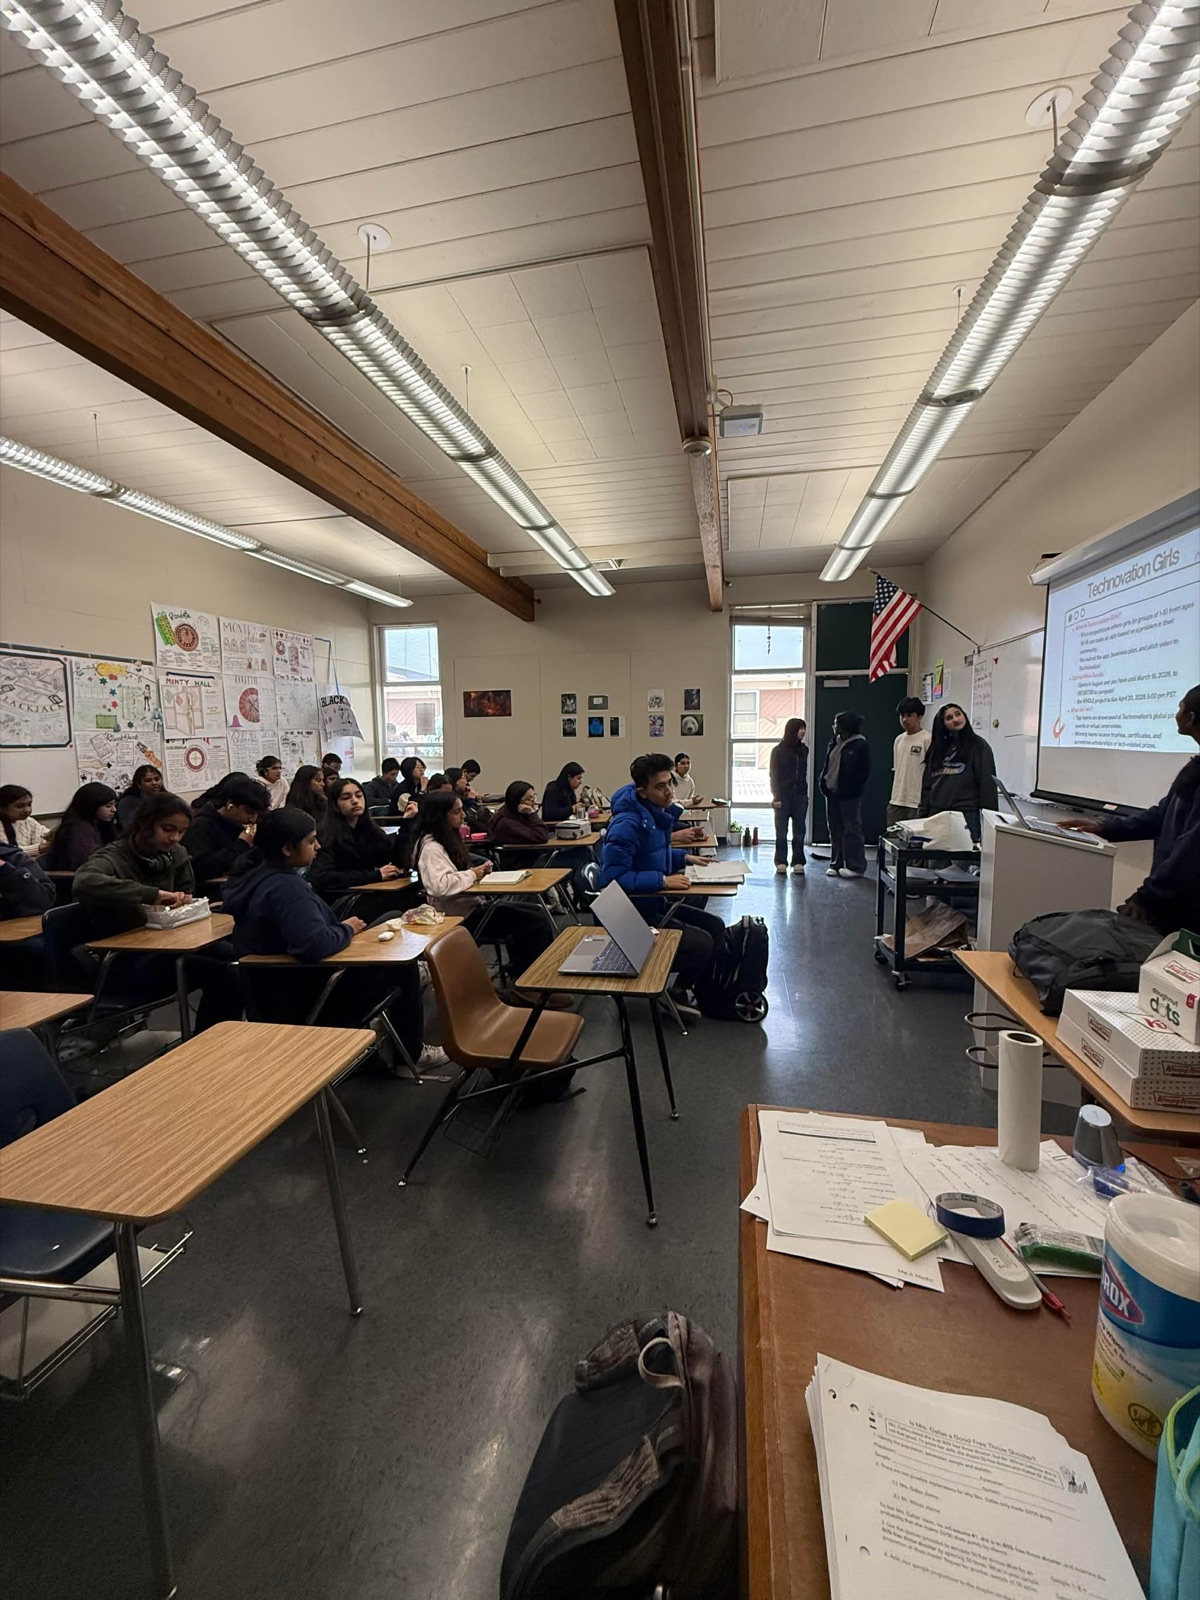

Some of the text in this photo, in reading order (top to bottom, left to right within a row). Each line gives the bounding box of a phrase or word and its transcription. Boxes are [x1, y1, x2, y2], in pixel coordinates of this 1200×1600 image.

[1088, 548, 1180, 598] Technovation Girls
[1138, 614, 1153, 624] groups
[1169, 605, 1181, 613] from
[1182, 602, 1195, 611] ages
[1147, 643, 1158, 652] pitch
[1159, 640, 1172, 648] video
[3, 695, 65, 713] LACKJACK
[1166, 690, 1177, 699] PST
[1122, 712, 1152, 720] Technovation's
[1153, 712, 1168, 721] global
[1152, 987, 1179, 1007] doughnut
[915, 1421, 928, 1431] Mrs.
[954, 1434, 972, 1443] Good
[973, 1438, 987, 1448] Free
[988, 1442, 1007, 1453] Throw
